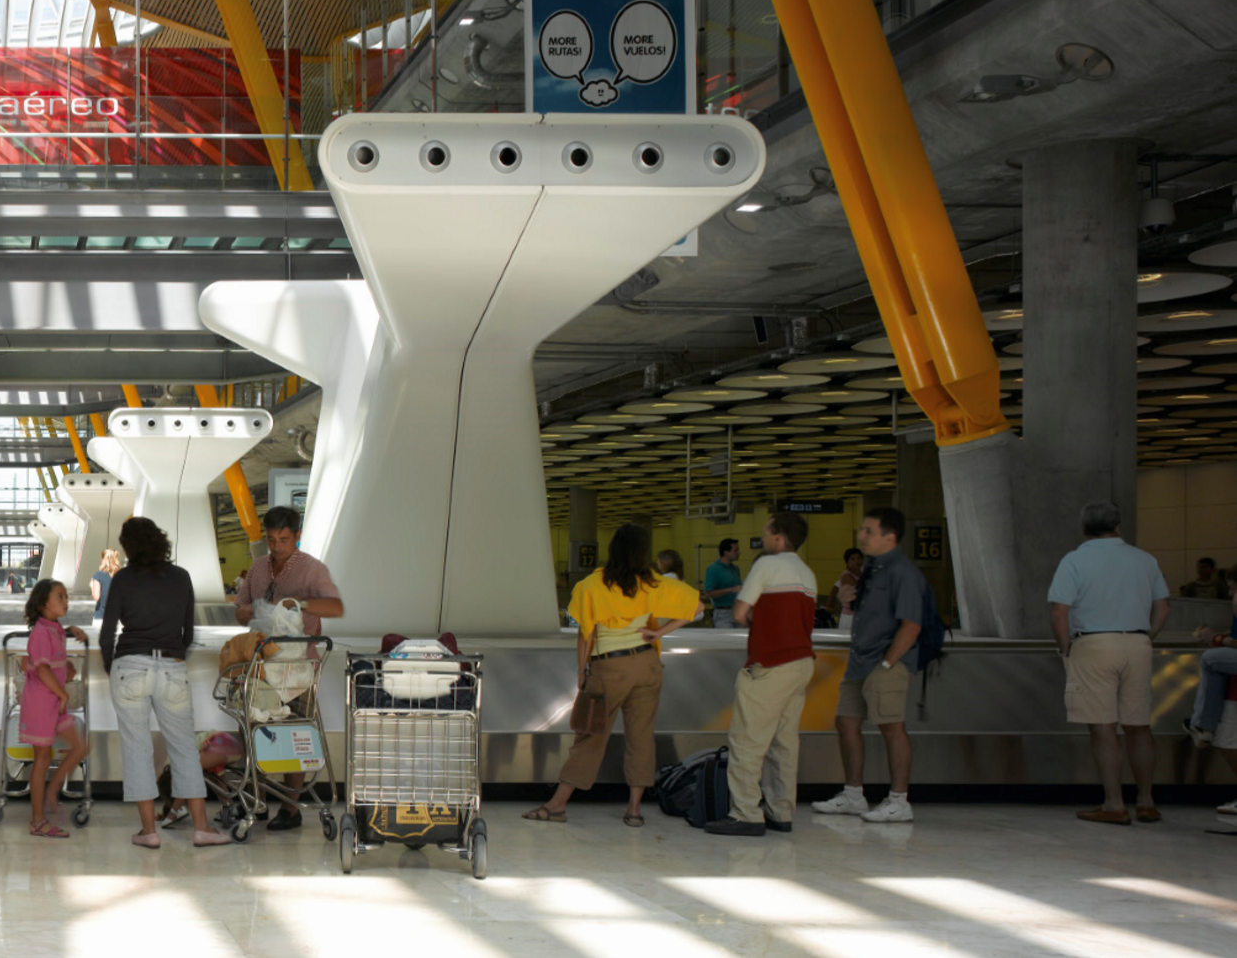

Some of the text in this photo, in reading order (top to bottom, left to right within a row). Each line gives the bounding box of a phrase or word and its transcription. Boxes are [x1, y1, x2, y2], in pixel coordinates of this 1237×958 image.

[548, 36, 577, 46] MORE
[623, 35, 654, 45] MORE
[548, 47, 582, 57] RUTAS!
[623, 46, 666, 56] VUELOS!
[918, 541, 940, 558] 16
[581, 555, 595, 567] 17
